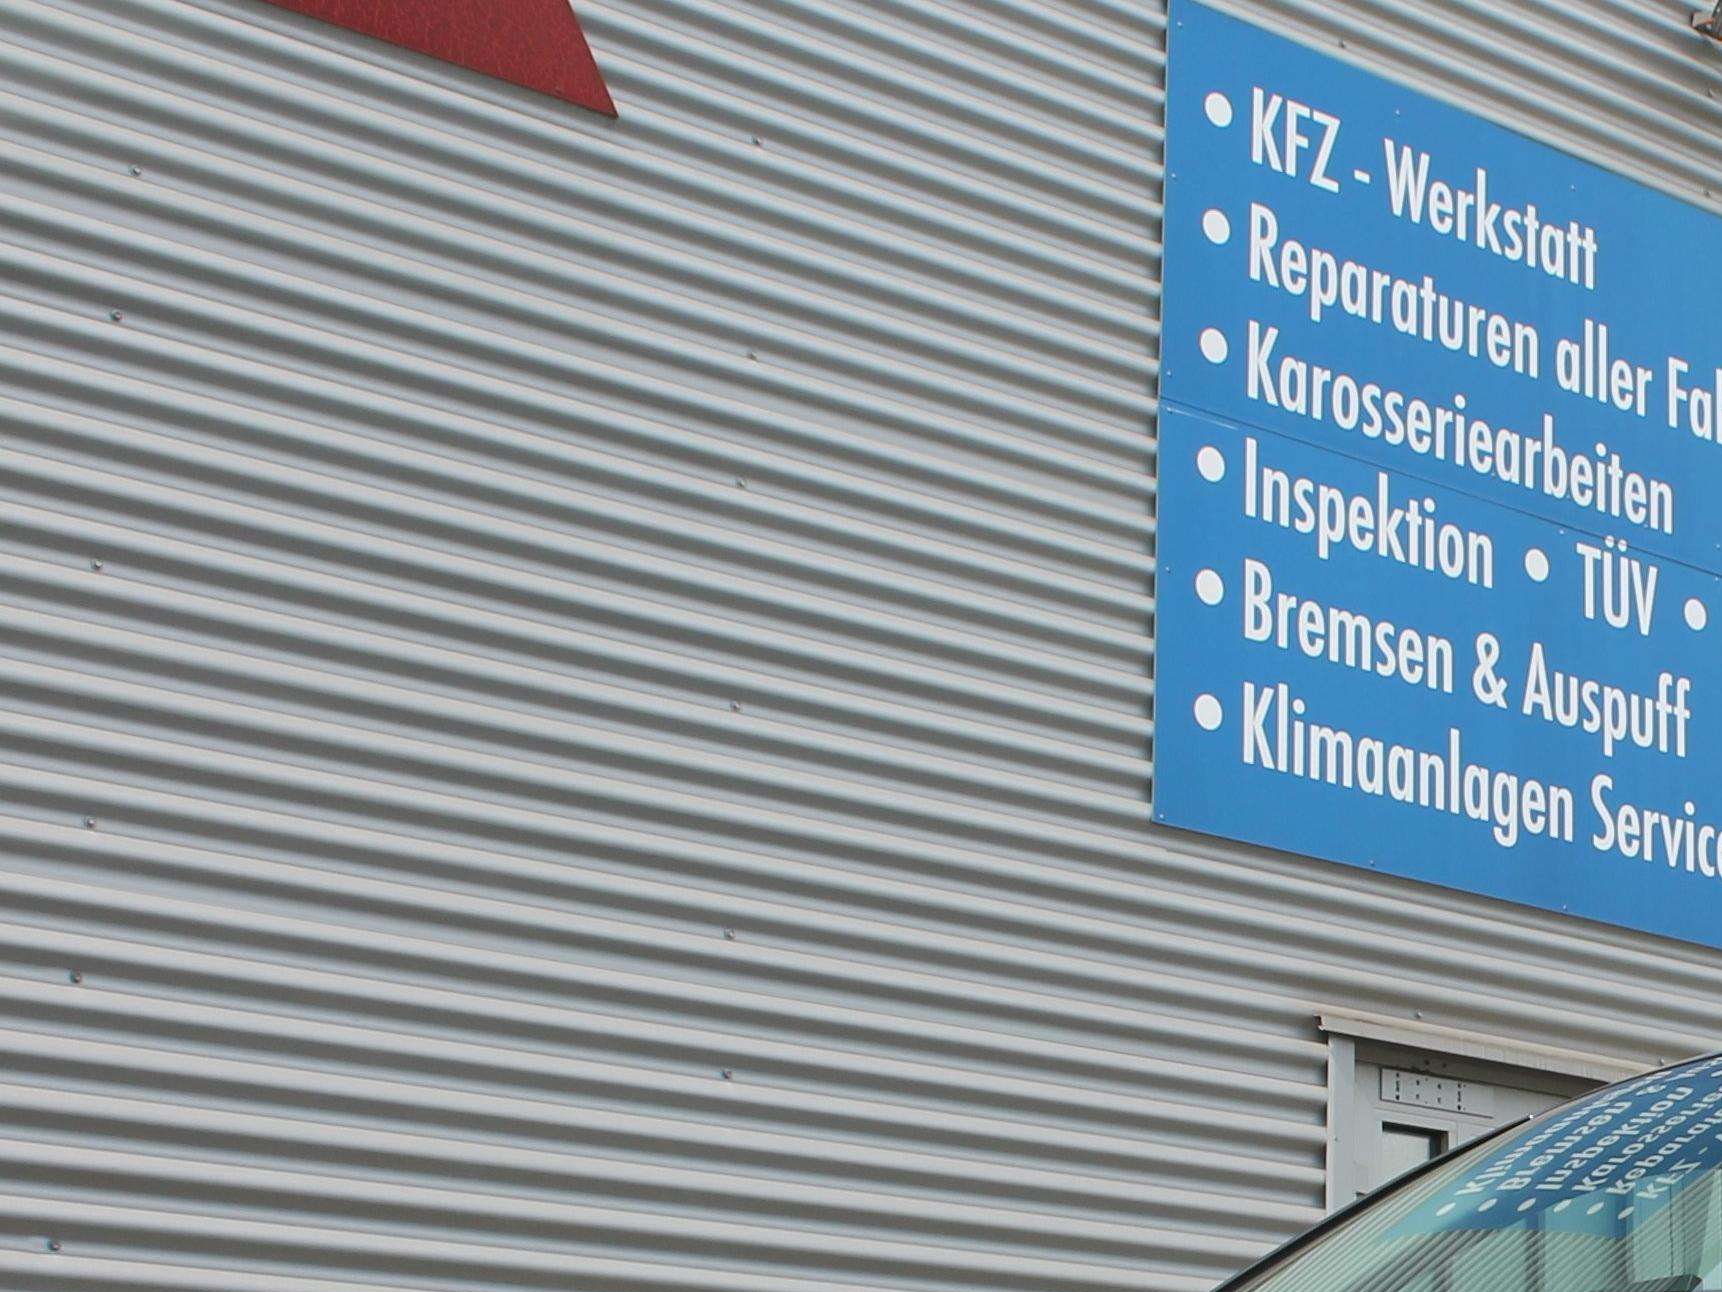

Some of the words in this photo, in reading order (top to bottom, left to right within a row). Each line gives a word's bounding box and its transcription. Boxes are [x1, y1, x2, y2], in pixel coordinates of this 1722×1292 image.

[1251, 86, 1340, 192] KFZ
[1384, 137, 1599, 289] Werkstatt
[1248, 202, 1539, 378] Reparaturen
[1556, 318, 1653, 416] aller
[1246, 319, 1673, 534] Karosseriearbeiten
[1244, 437, 1494, 588] Inspektion
[1576, 535, 1659, 636] TÜV
[1243, 558, 1453, 693] Bremsen
[1472, 632, 1508, 709] &
[1522, 642, 1691, 758] Auspuff
[1242, 681, 1574, 847] Klimaanlagen
